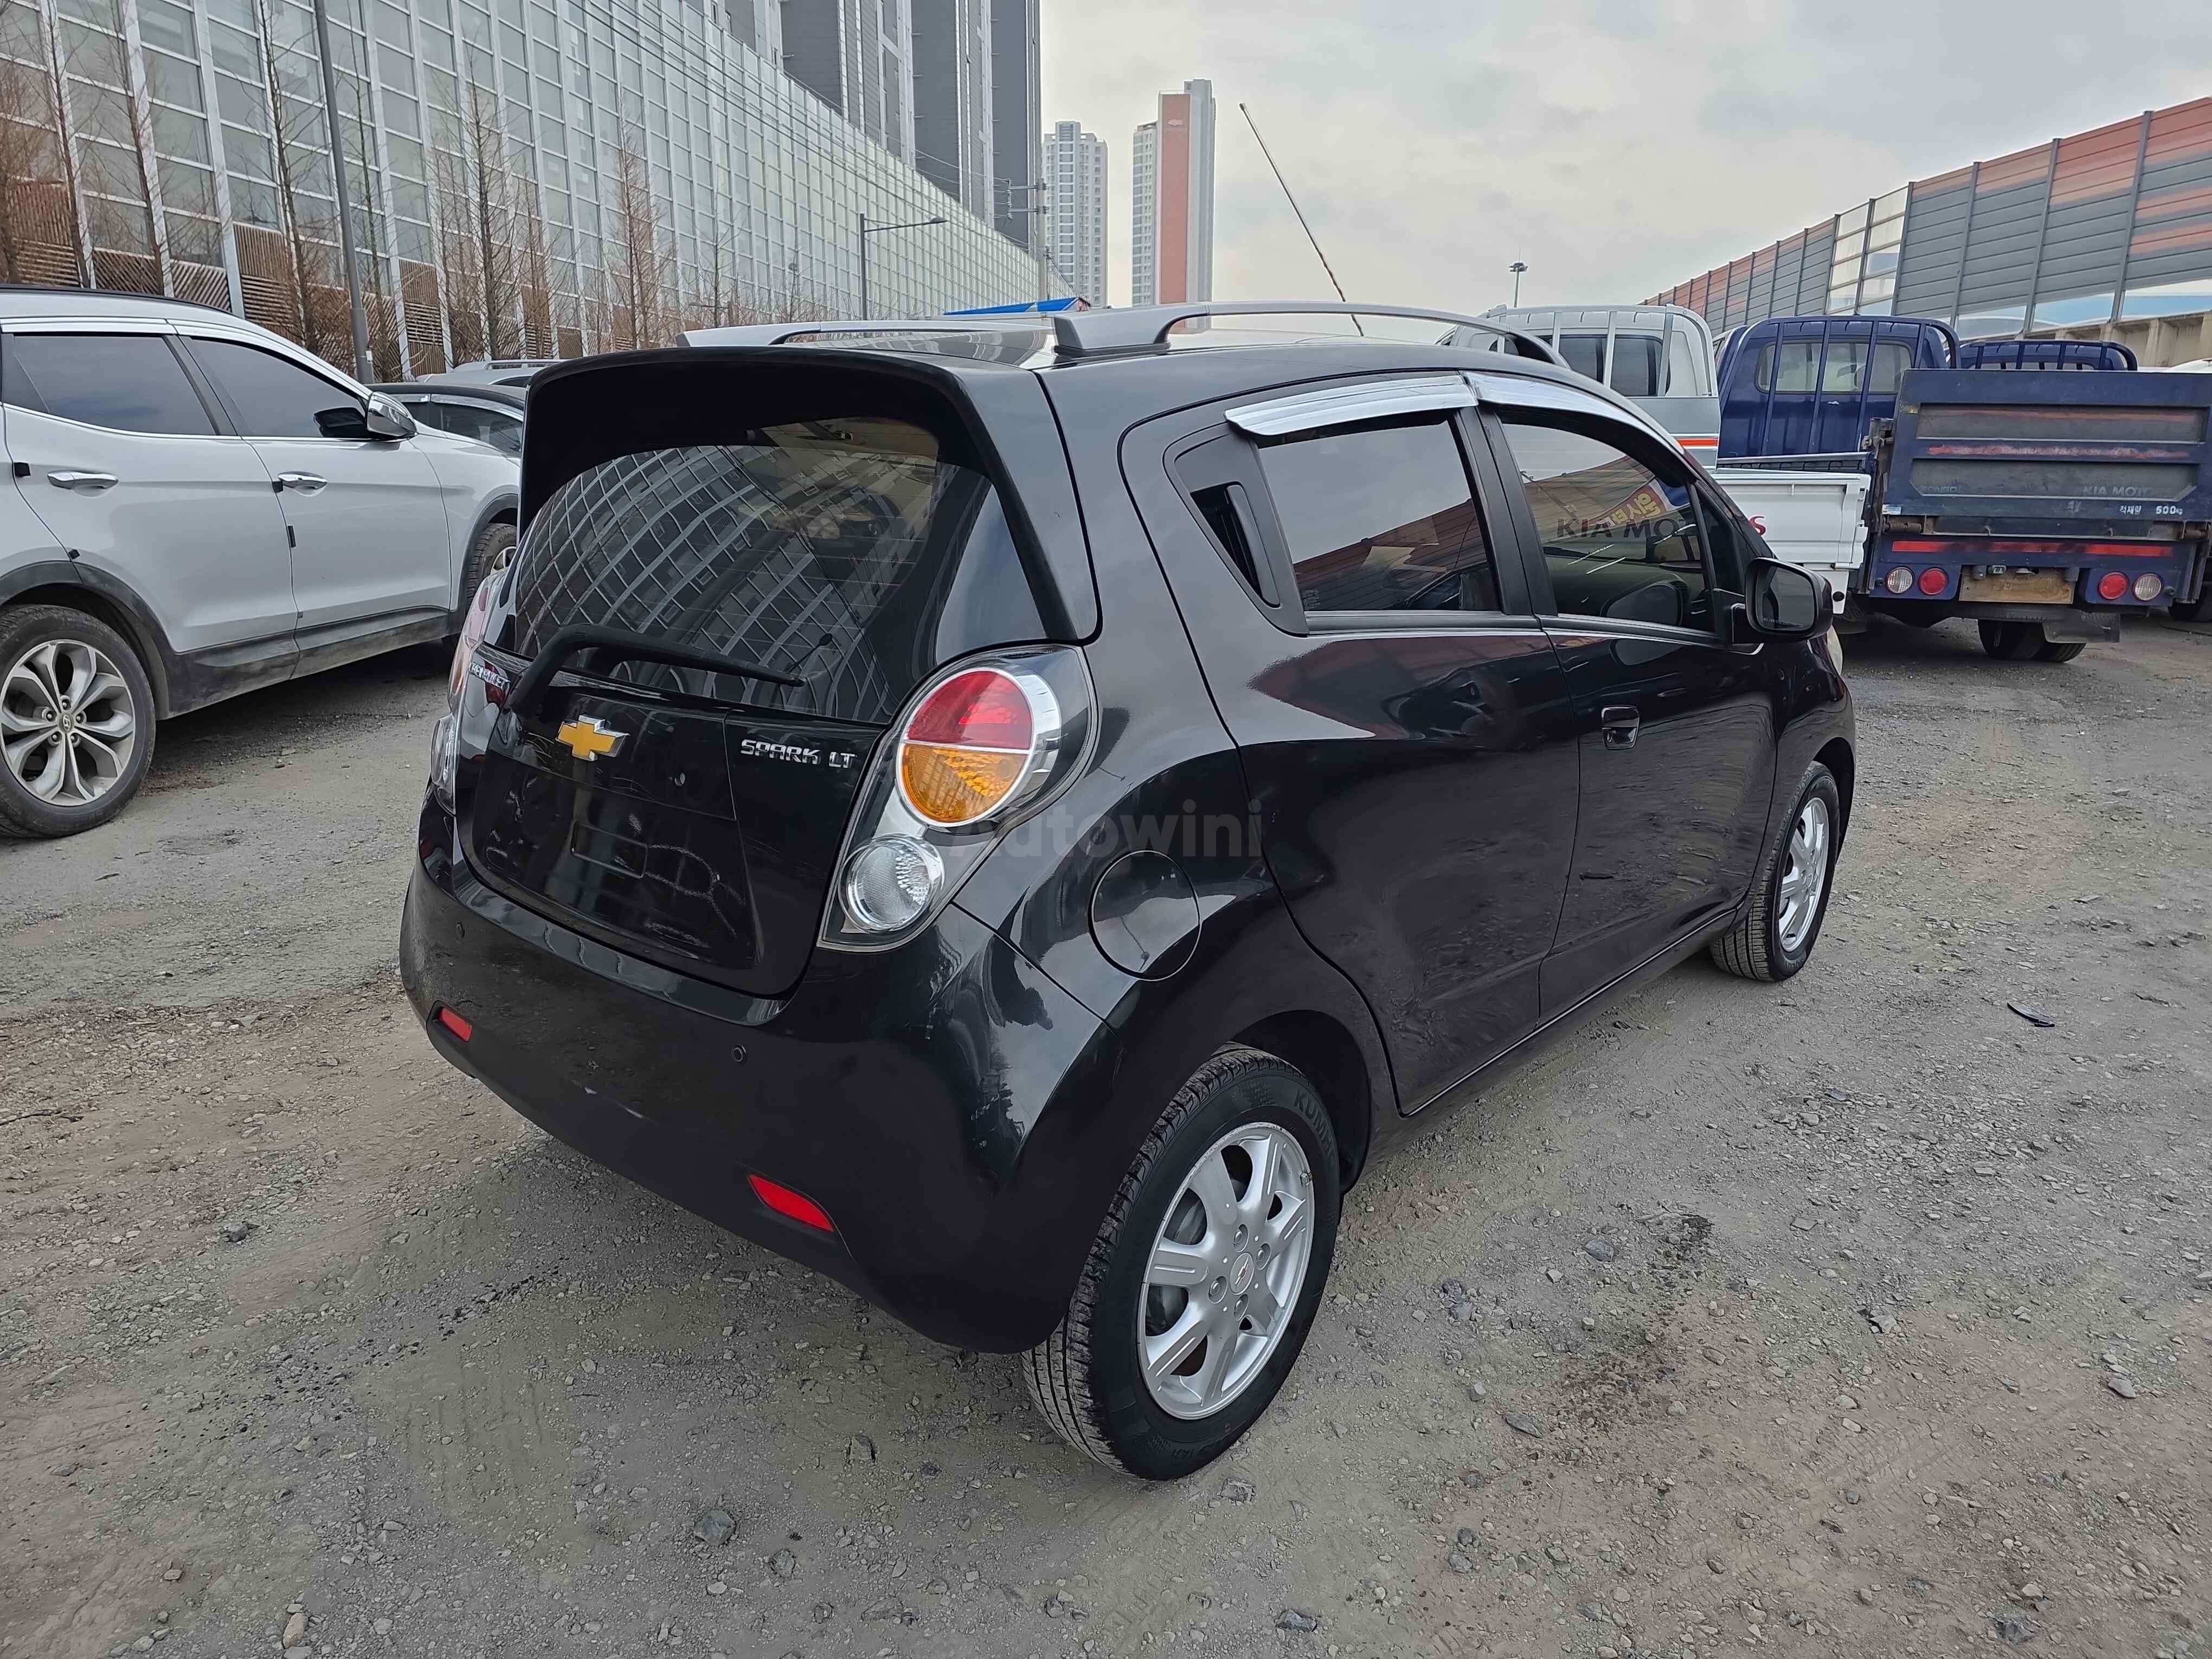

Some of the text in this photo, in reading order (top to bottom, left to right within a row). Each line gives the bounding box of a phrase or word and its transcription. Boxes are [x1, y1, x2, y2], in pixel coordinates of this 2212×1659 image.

[1557, 517, 1612, 538] KIA
[740, 738, 857, 769] SPARK LT
